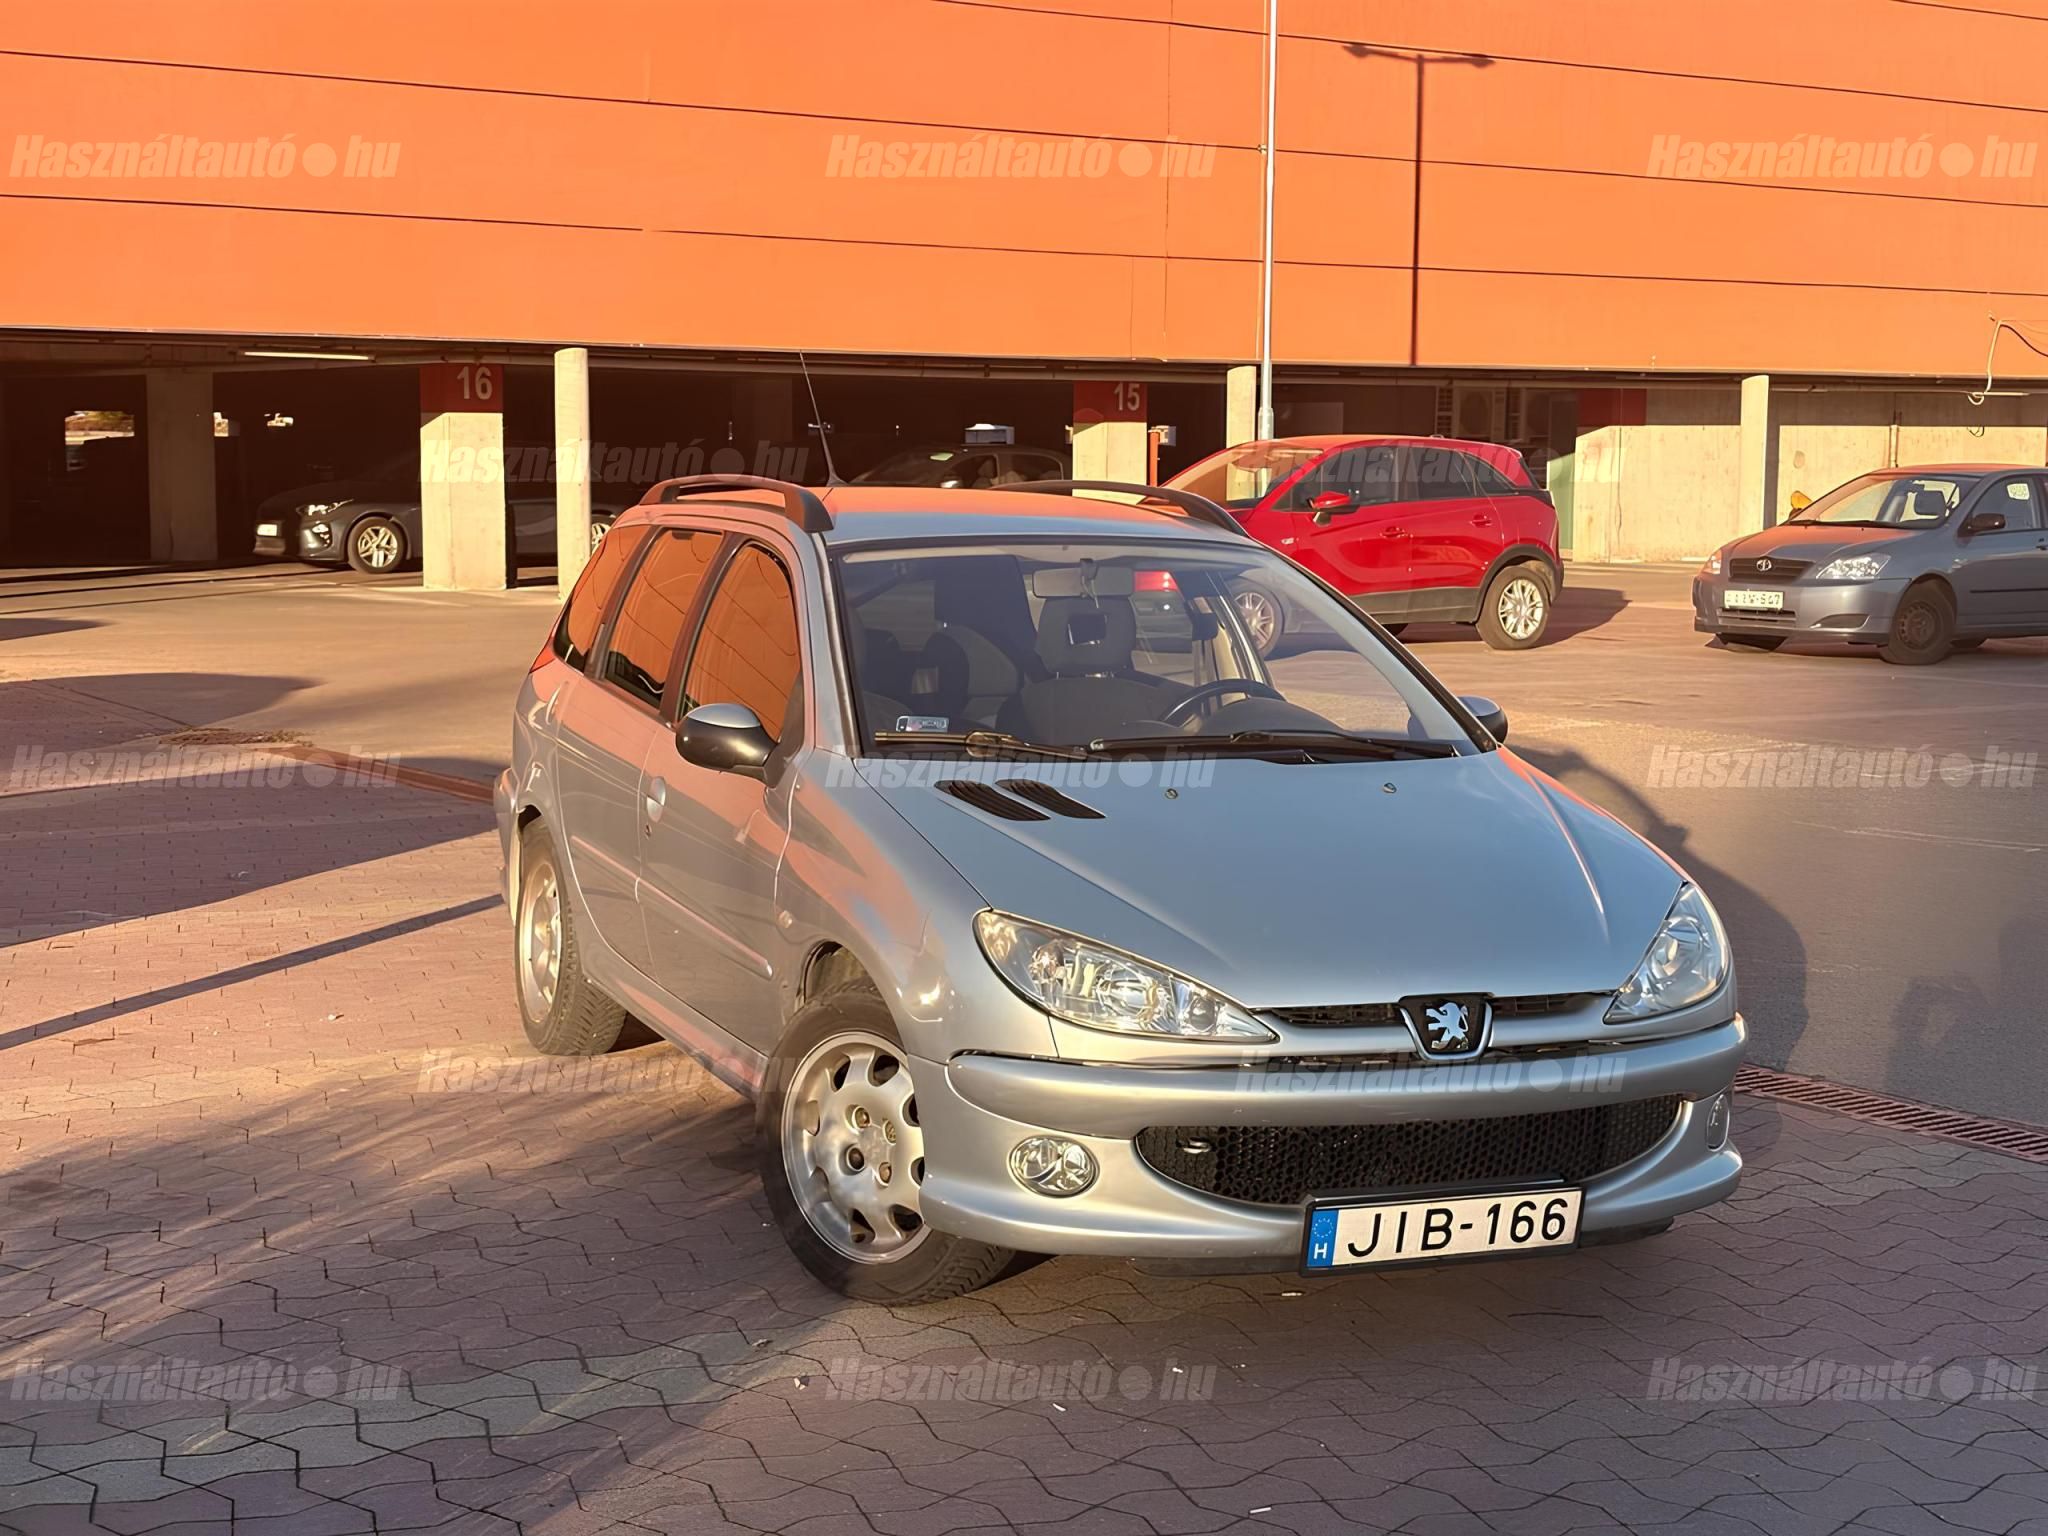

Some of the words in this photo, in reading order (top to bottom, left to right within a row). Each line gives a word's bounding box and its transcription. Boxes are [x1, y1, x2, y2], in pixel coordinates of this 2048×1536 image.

[456, 366, 493, 400] 16
[1114, 382, 1140, 411] 15
[1313, 1242, 1328, 1259] H
[1347, 1198, 1568, 1257] JIB-166
